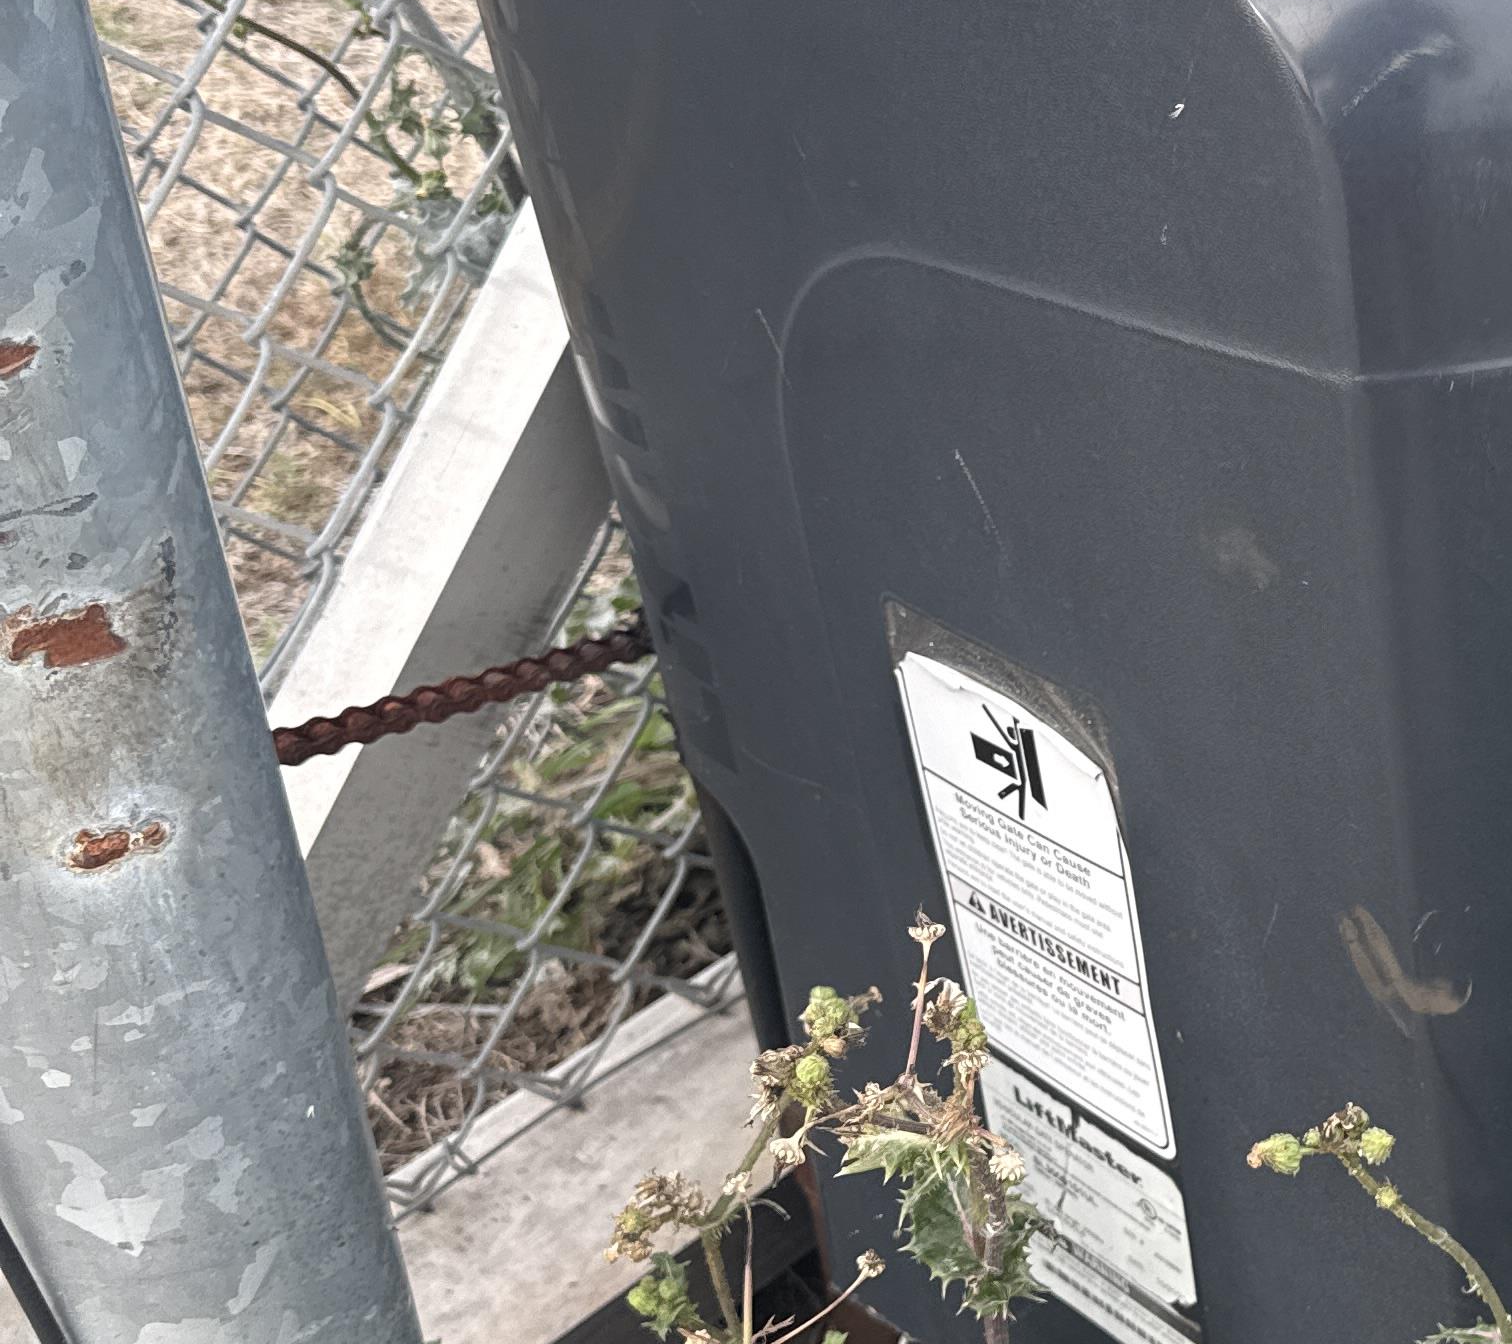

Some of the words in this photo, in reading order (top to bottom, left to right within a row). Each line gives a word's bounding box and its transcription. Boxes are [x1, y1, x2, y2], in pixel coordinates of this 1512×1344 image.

[954, 791, 995, 826] Moving
[997, 817, 1024, 841] Gate
[1027, 834, 1050, 855] Can
[1053, 848, 1092, 877] Cause
[959, 807, 1002, 840] Serious
[1004, 835, 1037, 862] Injury
[1040, 855, 1053, 868] or
[1055, 862, 1092, 889] Death
[975, 921, 996, 942] Une
[1042, 966, 1057, 979] en
[1059, 976, 1126, 1022] mouvement
[989, 902, 1121, 996] AVERTISSEMENT
[997, 958, 1049, 997] blessures
[1051, 994, 1066, 1009] ou
[1068, 1002, 1079, 1016] la
[1017, 961, 1054, 989] causer
[1056, 985, 1071, 1000] de
[1073, 996, 1112, 1025] graves
[1013, 1085, 1143, 1184] LiftMaster
